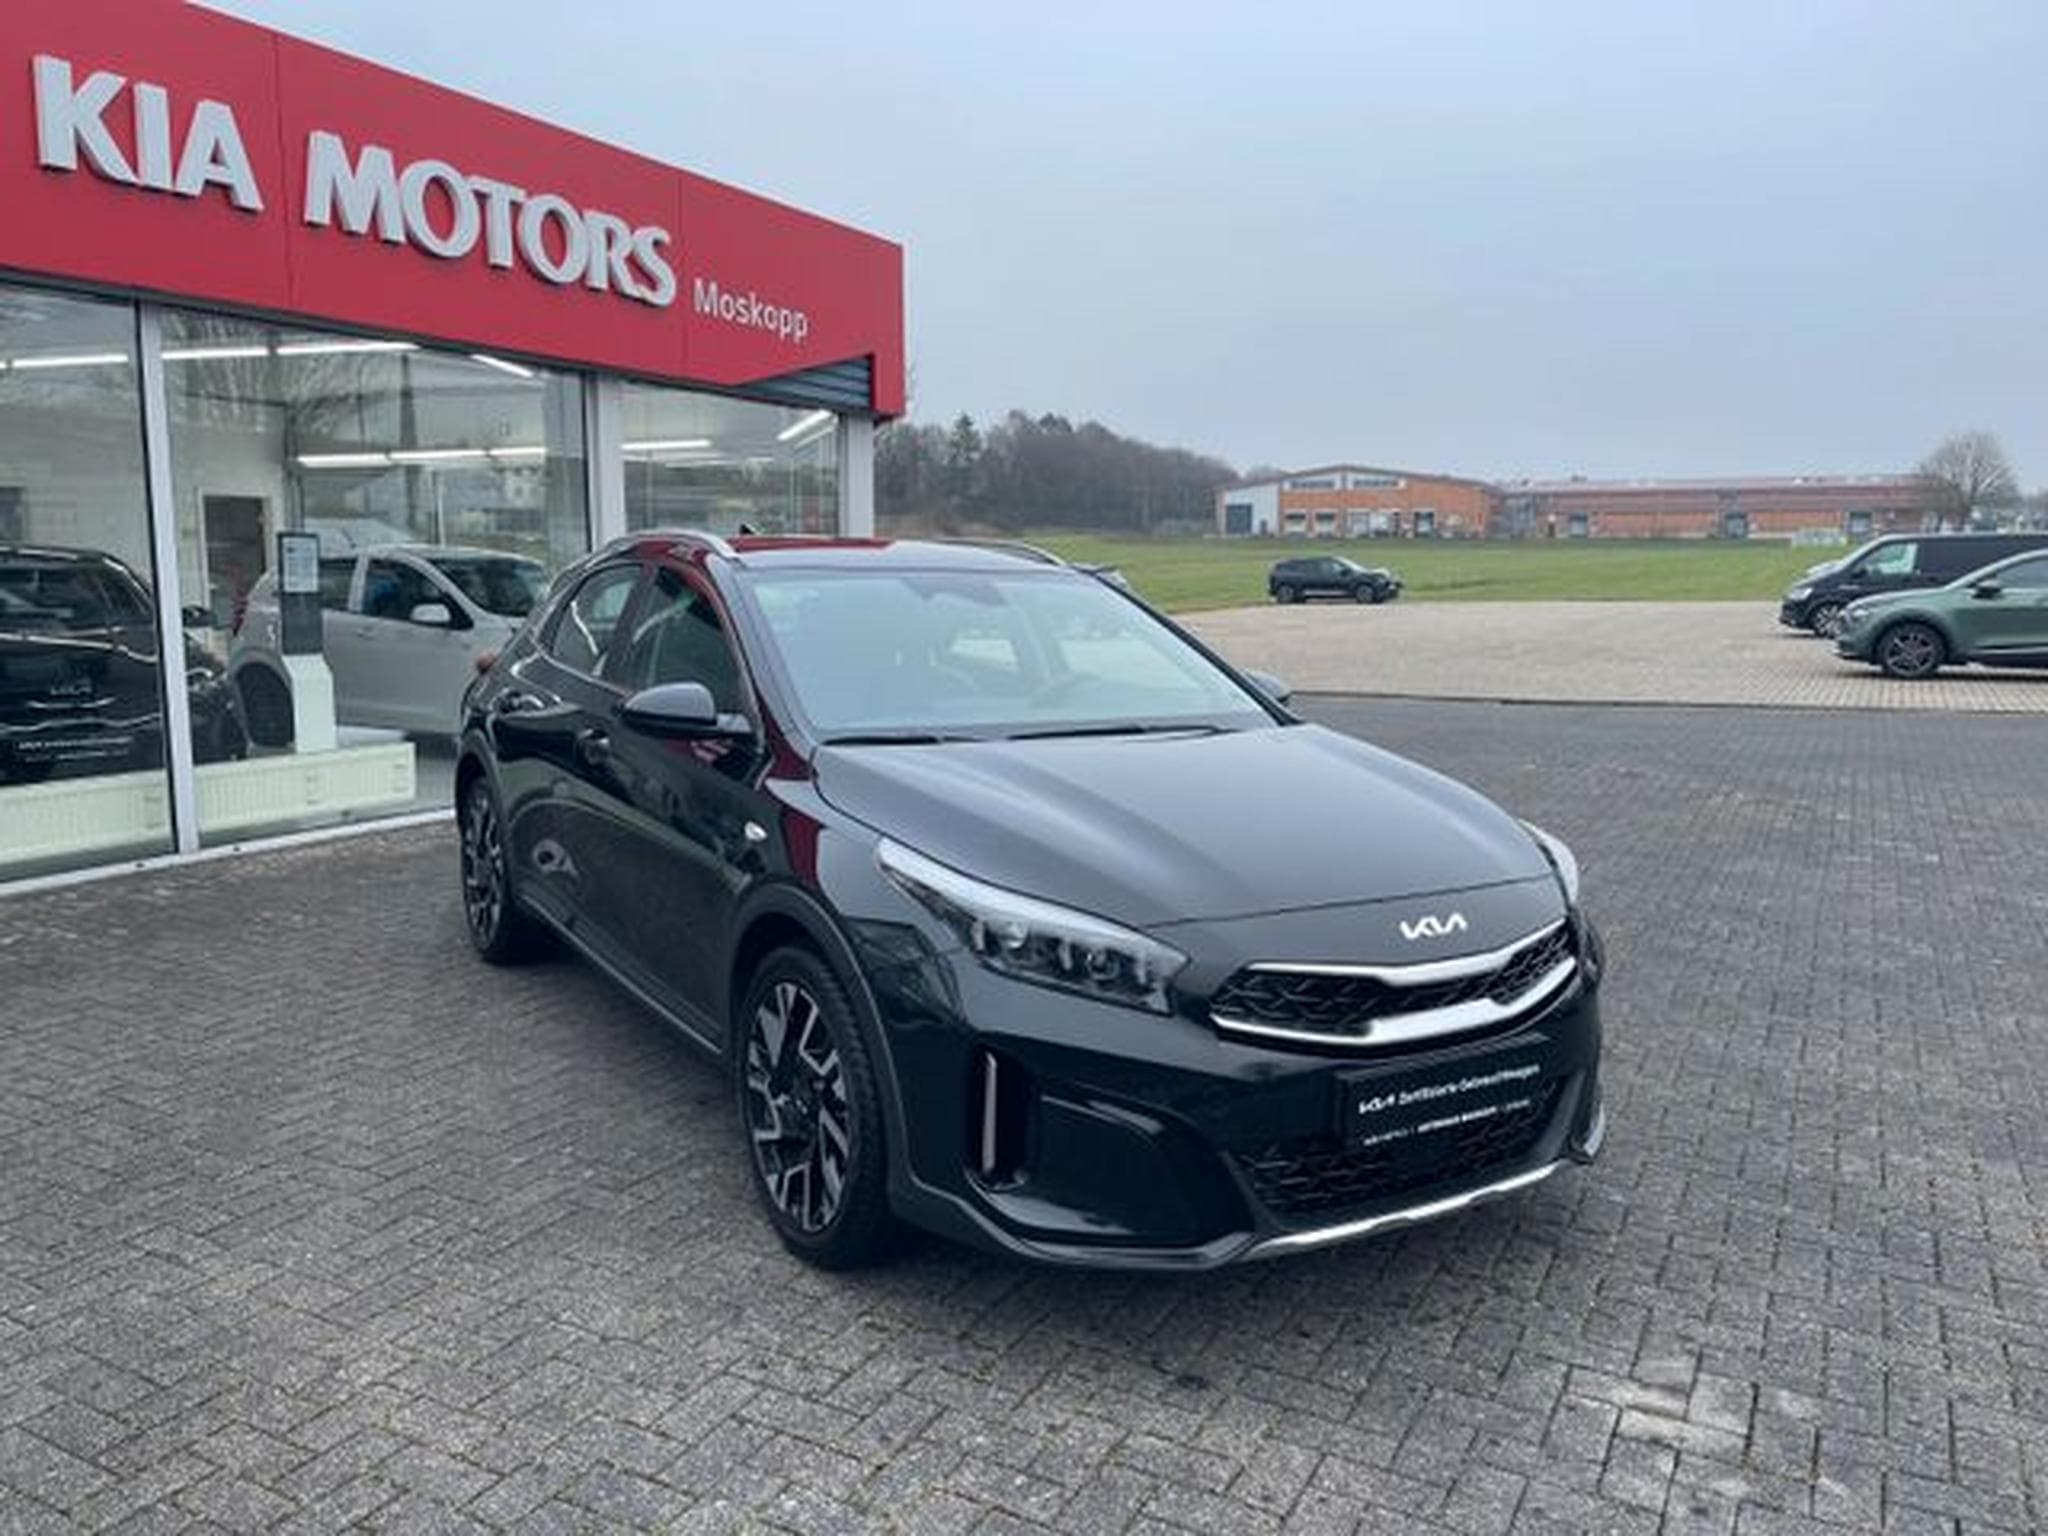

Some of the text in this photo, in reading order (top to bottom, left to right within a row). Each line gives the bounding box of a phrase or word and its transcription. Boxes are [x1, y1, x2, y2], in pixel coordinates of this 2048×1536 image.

[32, 54, 678, 308] KIA MOTORS
[693, 278, 809, 343] Moskopp
